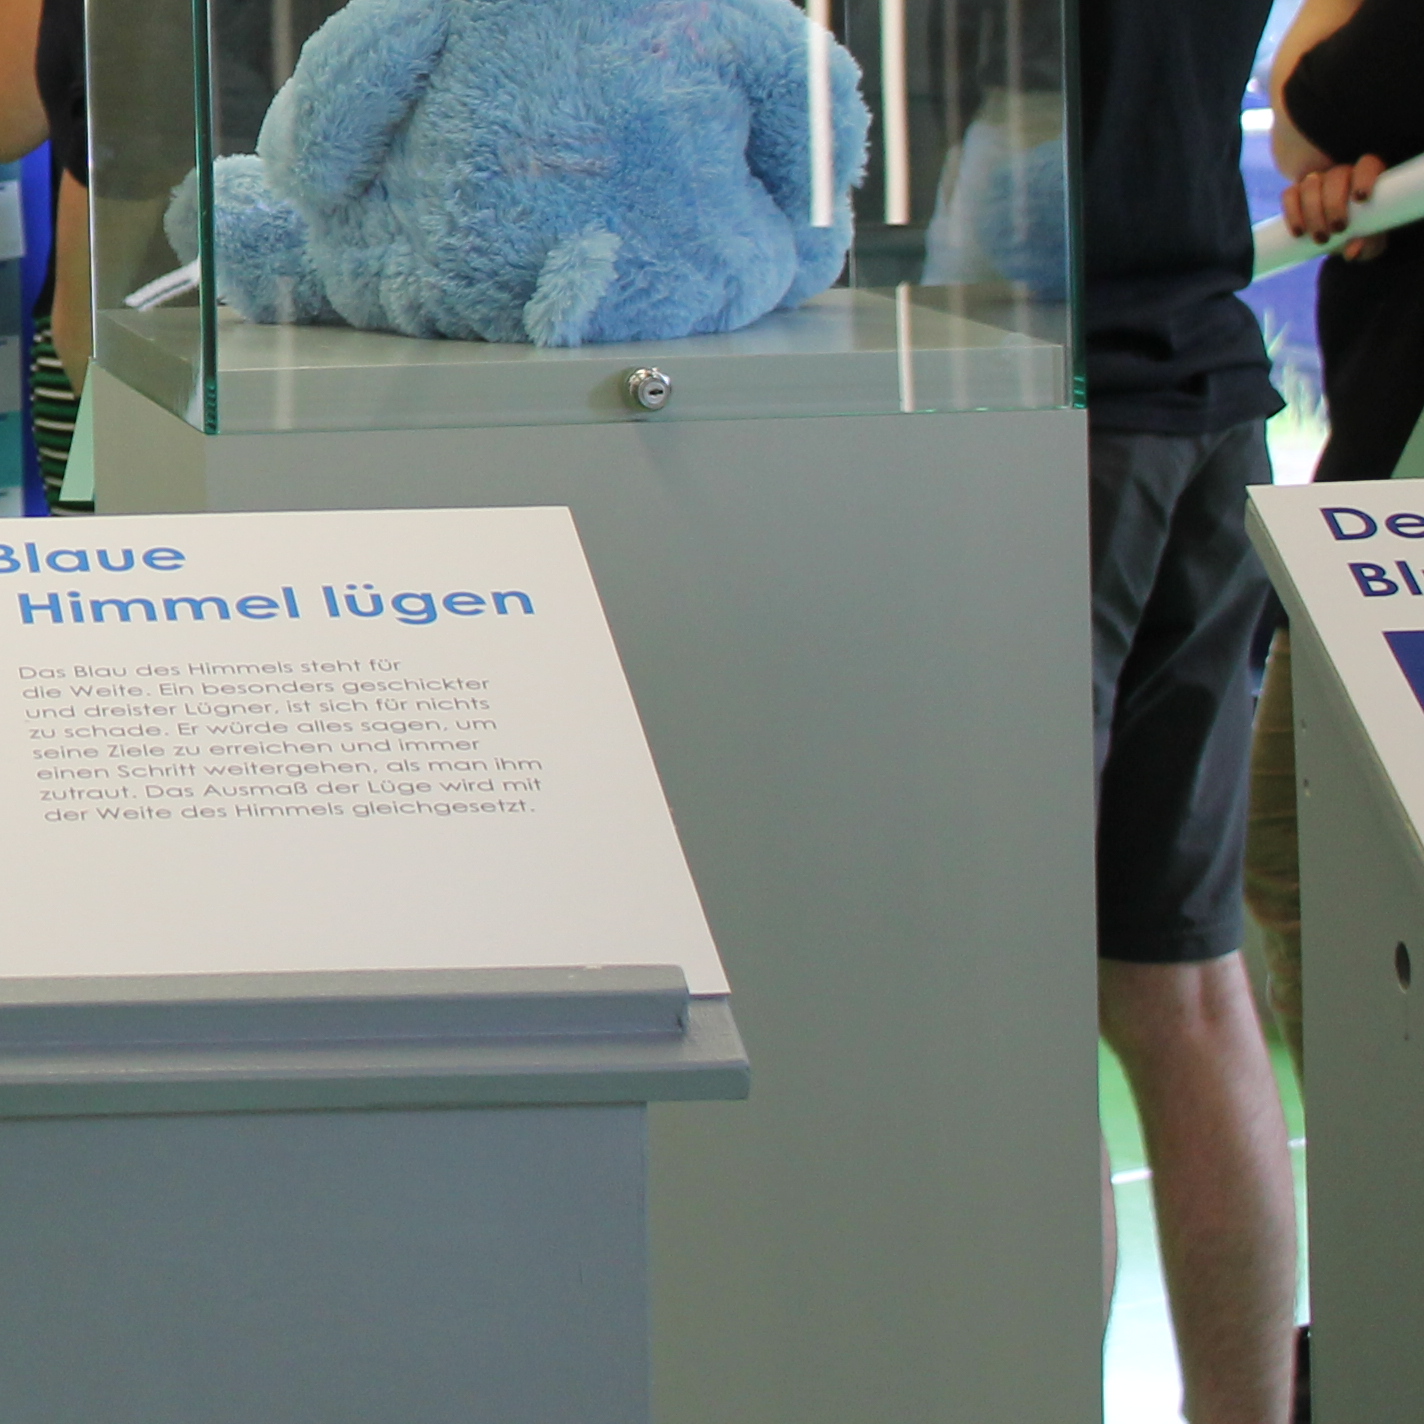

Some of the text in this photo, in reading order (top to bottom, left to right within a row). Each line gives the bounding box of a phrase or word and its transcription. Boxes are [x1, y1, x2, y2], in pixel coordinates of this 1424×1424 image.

[1347, 560, 1424, 598] Bl
[18, 587, 300, 624] Himmel
[322, 584, 535, 625] lügen
[18, 658, 406, 680] Das Blau des Himmels steht für
[22, 677, 490, 700] die Weite. Ein besonders geschickter
[25, 704, 76, 720] und
[83, 702, 178, 718] dreister
[285, 699, 311, 714] ist
[318, 698, 369, 713] sich
[375, 697, 408, 712] für
[415, 696, 491, 712] nichts
[25, 724, 56, 740] zu
[63, 723, 169, 739] schade.
[176, 722, 200, 736] Er
[205, 720, 289, 735] würde
[296, 719, 354, 734] alles
[455, 719, 498, 731] um
[32, 737, 480, 760] seine Ziele zu erreichen und immer
[36, 765, 110, 781] einen
[116, 762, 196, 779] Schritt
[386, 758, 421, 773] als
[427, 760, 488, 772] man
[493, 757, 543, 771] ihm
[39, 777, 541, 801] zutraut. Das Ausmaß der Lüge wird mit
[44, 798, 535, 822] der Weite des Himmels gleichgesetzt.
